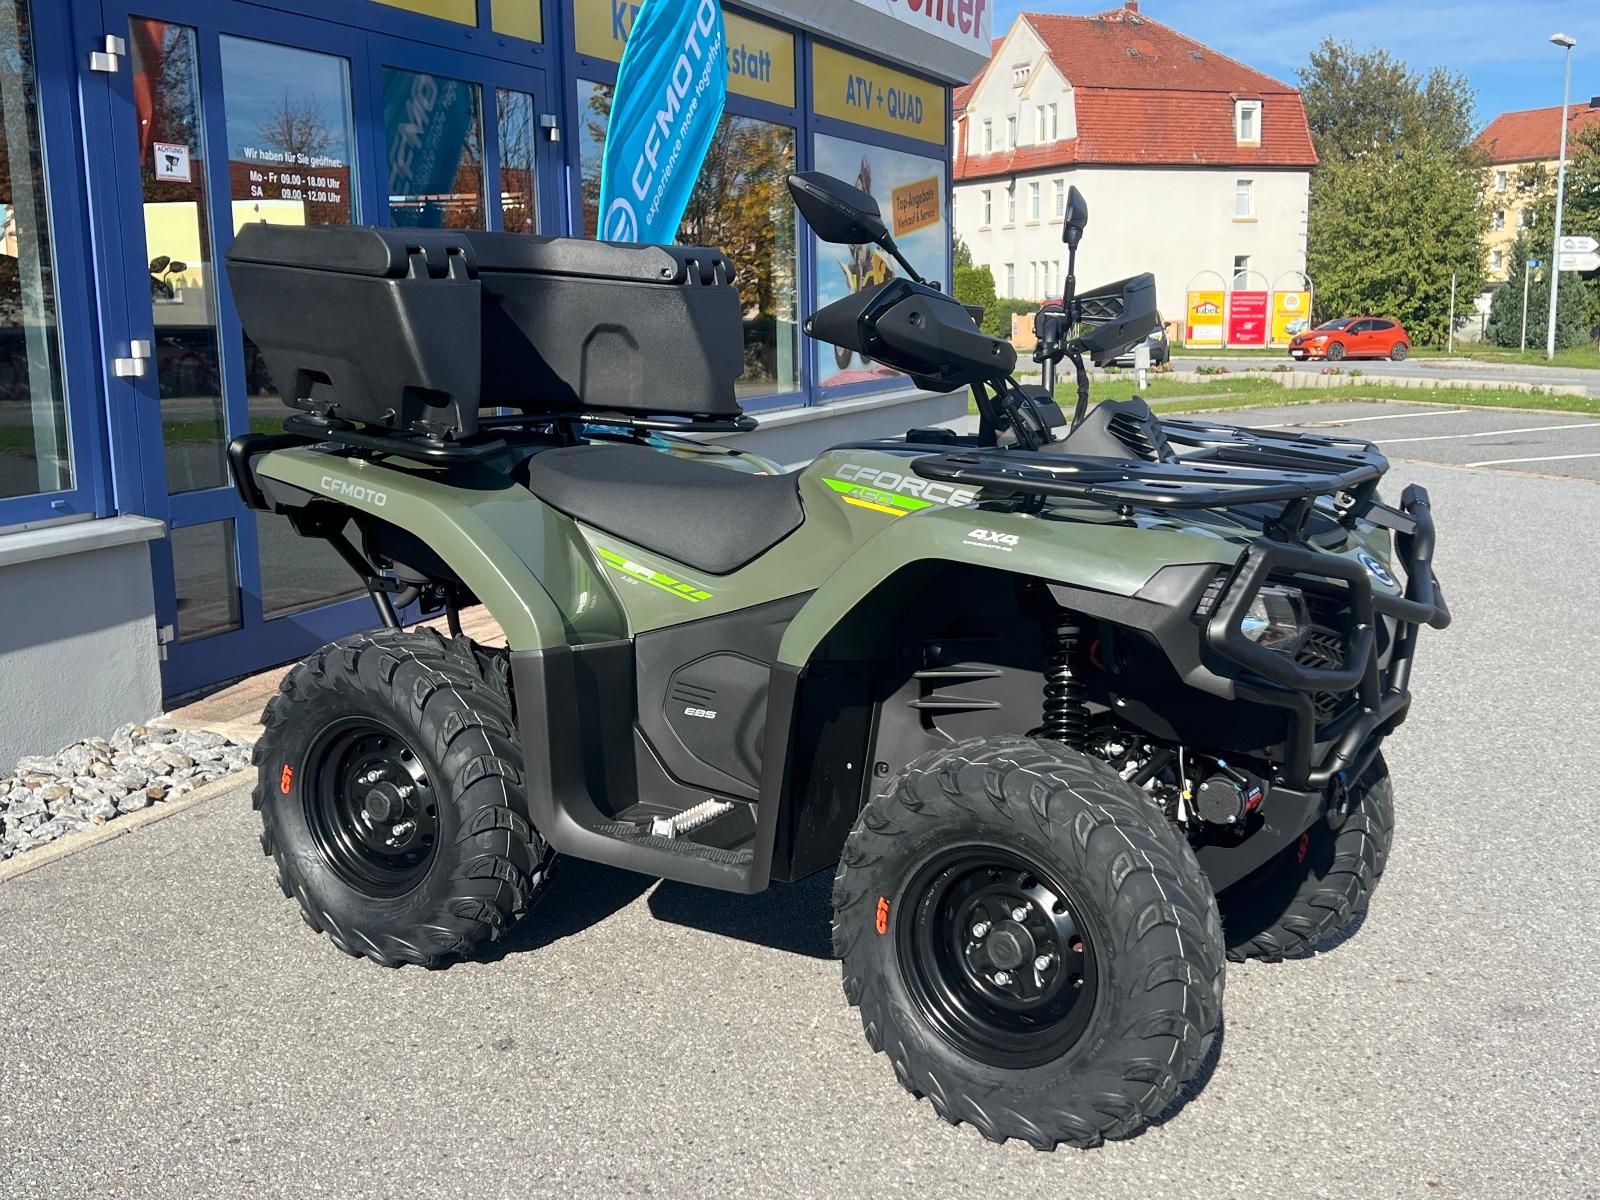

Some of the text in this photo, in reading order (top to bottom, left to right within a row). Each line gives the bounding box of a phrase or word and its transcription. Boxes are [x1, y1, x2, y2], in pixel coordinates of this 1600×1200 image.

[632, 0, 716, 201] CFMOTO
[846, 74, 873, 111] ATV
[887, 87, 923, 124] QUAD
[244, 147, 342, 168] Wir haben für Sie geöffnet:
[645, 139, 682, 225] experience
[680, 97, 699, 139] more
[250, 170, 262, 182] Mo
[269, 172, 277, 183] Fr
[281, 173, 300, 186] 09.00
[307, 176, 326, 188] 18.00
[327, 177, 340, 189] Uhr
[251, 186, 263, 197] SA
[282, 188, 301, 200] 09.00
[307, 190, 327, 202] 12.00
[328, 192, 341, 203] Uhr
[321, 475, 387, 507] CFMOTO
[834, 463, 977, 508] CFORCE
[967, 528, 1020, 546] 4X4
